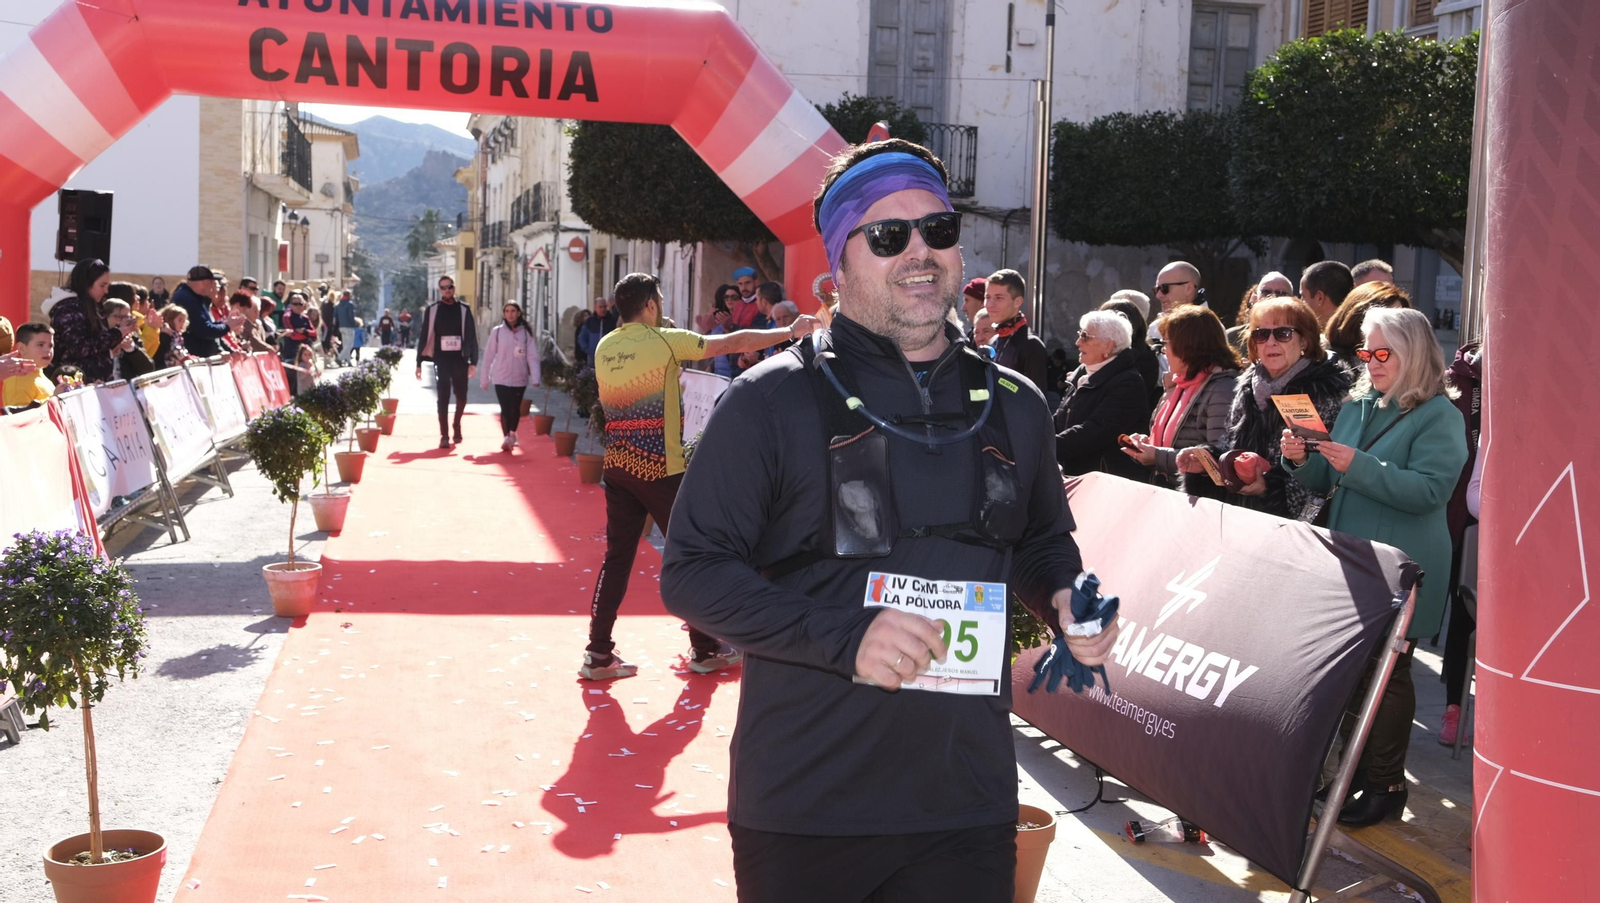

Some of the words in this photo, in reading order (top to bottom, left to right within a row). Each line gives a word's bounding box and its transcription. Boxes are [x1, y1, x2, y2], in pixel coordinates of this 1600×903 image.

[237, 0, 614, 33] NTAMIENTO
[248, 27, 600, 103] CANTORIA
[1471, 387, 1481, 415] BIMBA
[884, 593, 900, 605] LA
[905, 594, 962, 610] PÓLVORA
[891, 577, 908, 590] IV
[912, 579, 939, 595] CxM
[1108, 616, 1260, 709] AMERGY
[1088, 685, 1177, 739] www.teamergy.es
